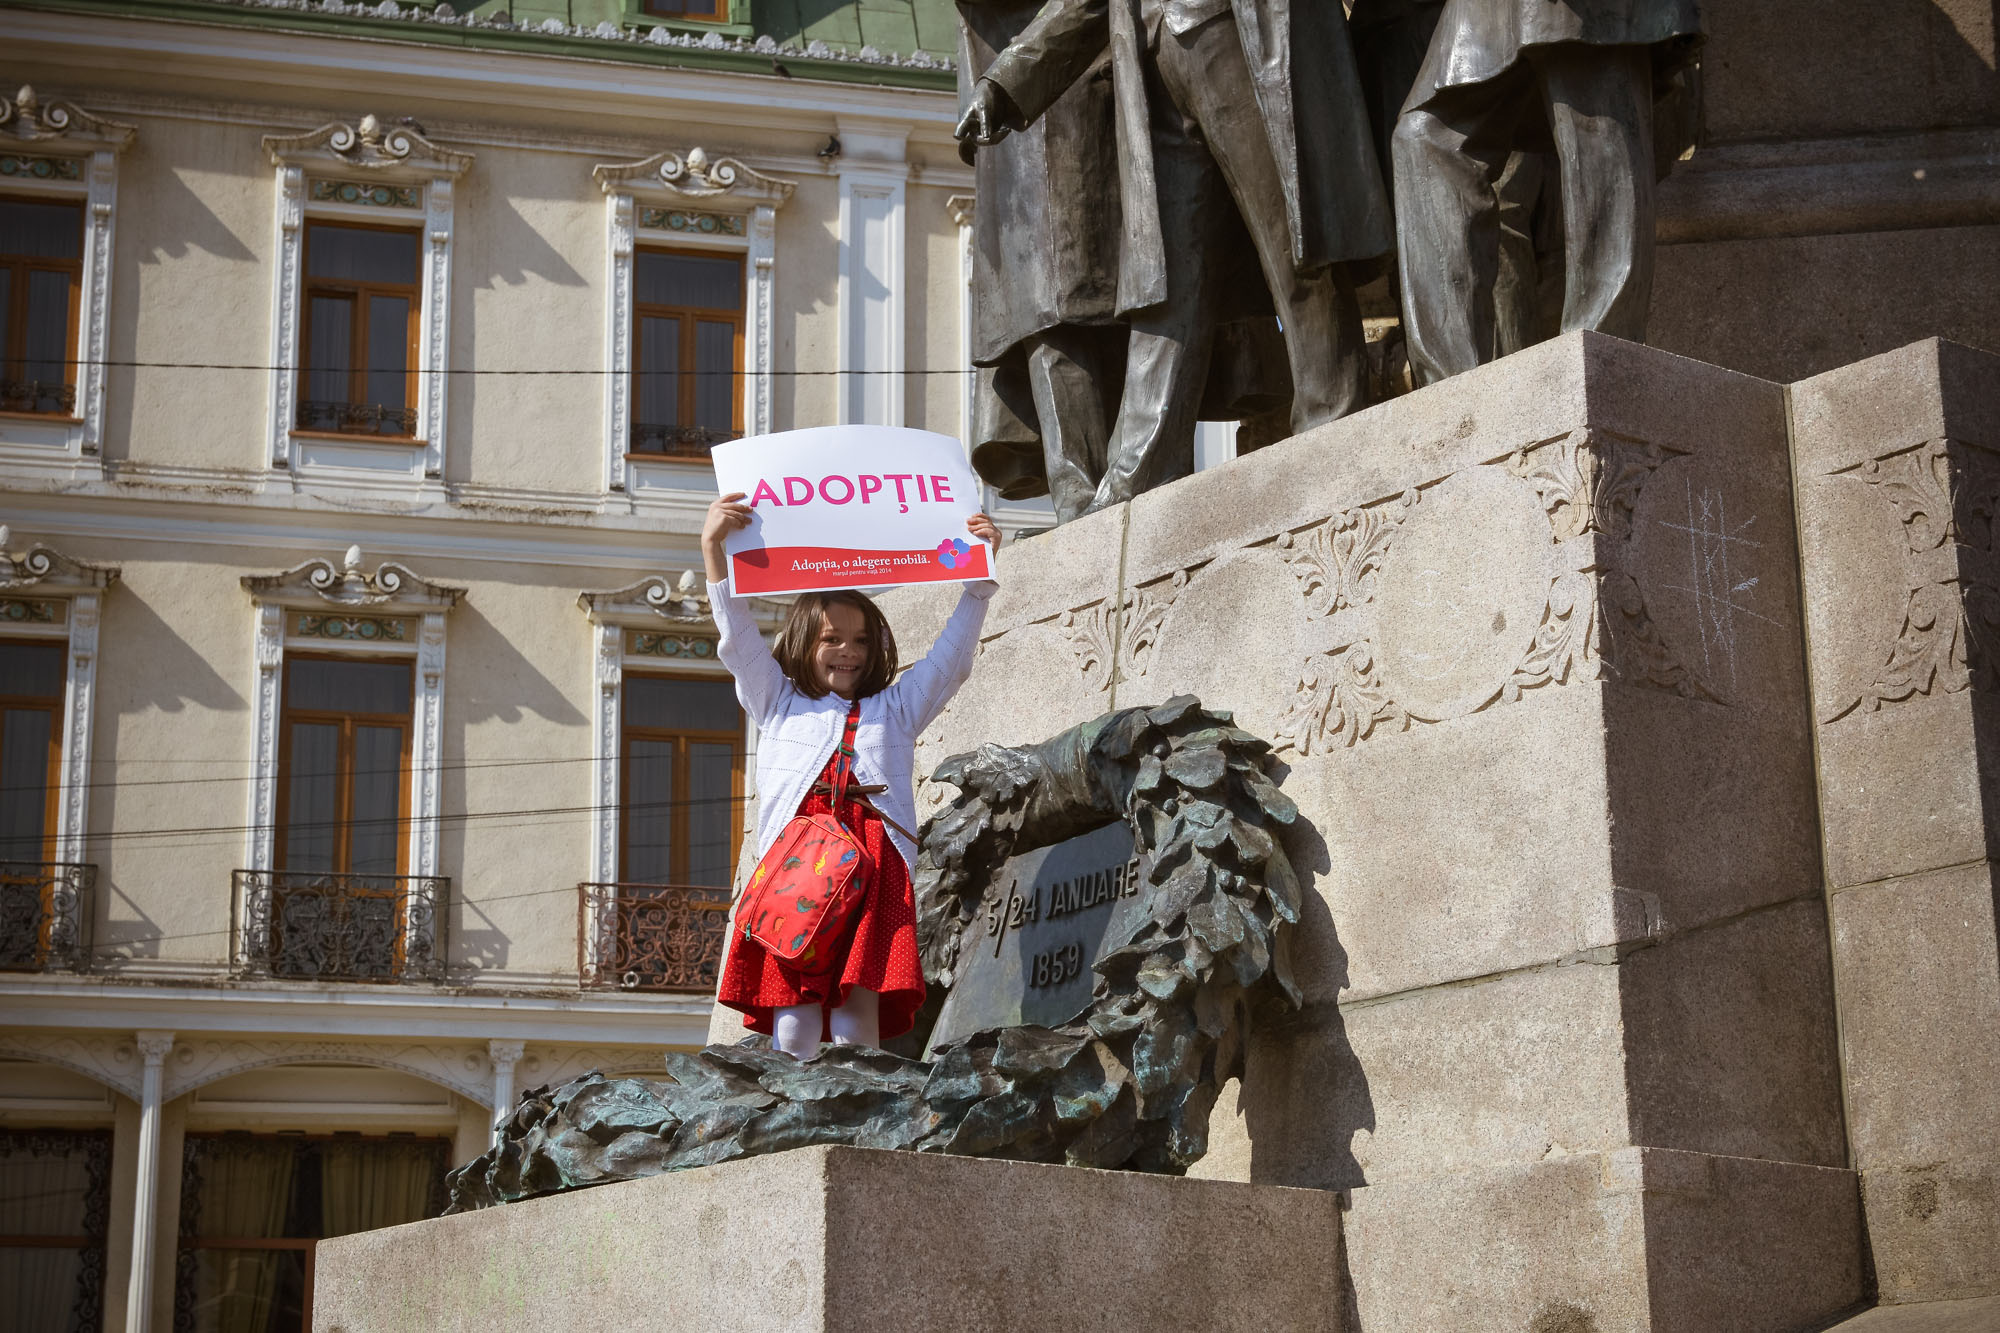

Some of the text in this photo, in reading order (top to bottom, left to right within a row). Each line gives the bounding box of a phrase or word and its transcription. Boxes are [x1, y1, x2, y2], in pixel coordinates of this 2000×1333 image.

[750, 474, 954, 513] ADOPȚIE
[842, 560, 850, 568] o
[852, 556, 891, 570] alegere
[893, 553, 931, 566] nobilă.
[987, 879, 1040, 958] 5/24
[1028, 942, 1082, 988] 1859
